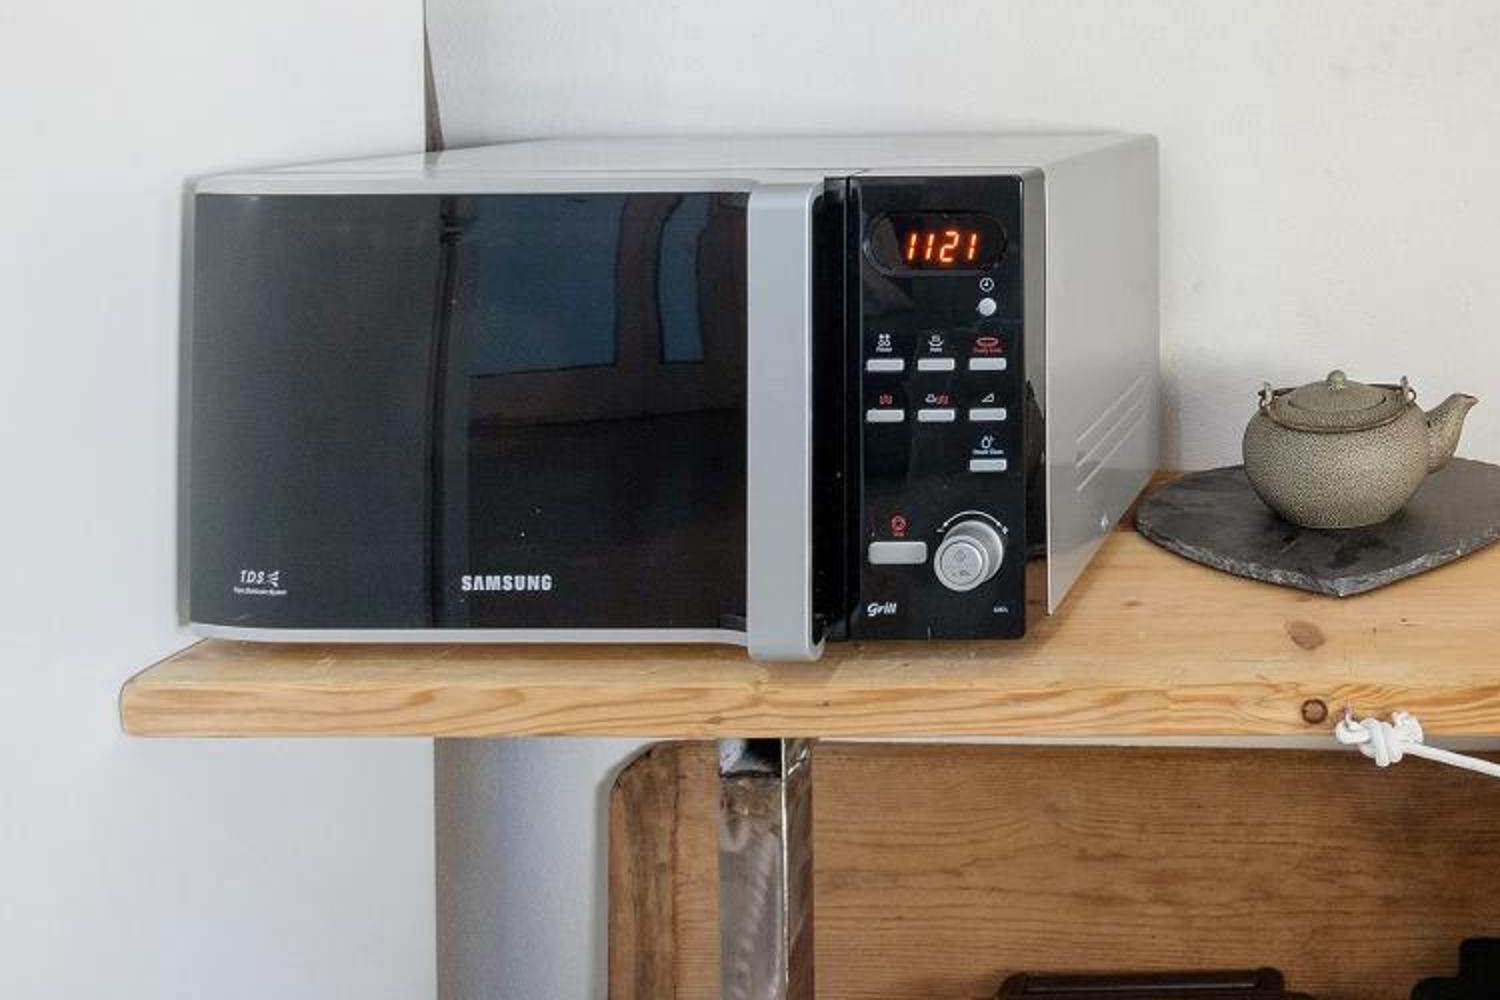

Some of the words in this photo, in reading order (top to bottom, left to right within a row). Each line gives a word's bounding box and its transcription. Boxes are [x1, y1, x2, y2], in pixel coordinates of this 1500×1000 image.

[907, 230, 977, 263] 1121
[461, 574, 553, 591] SAMSUNG
[867, 601, 897, 617] Grill
